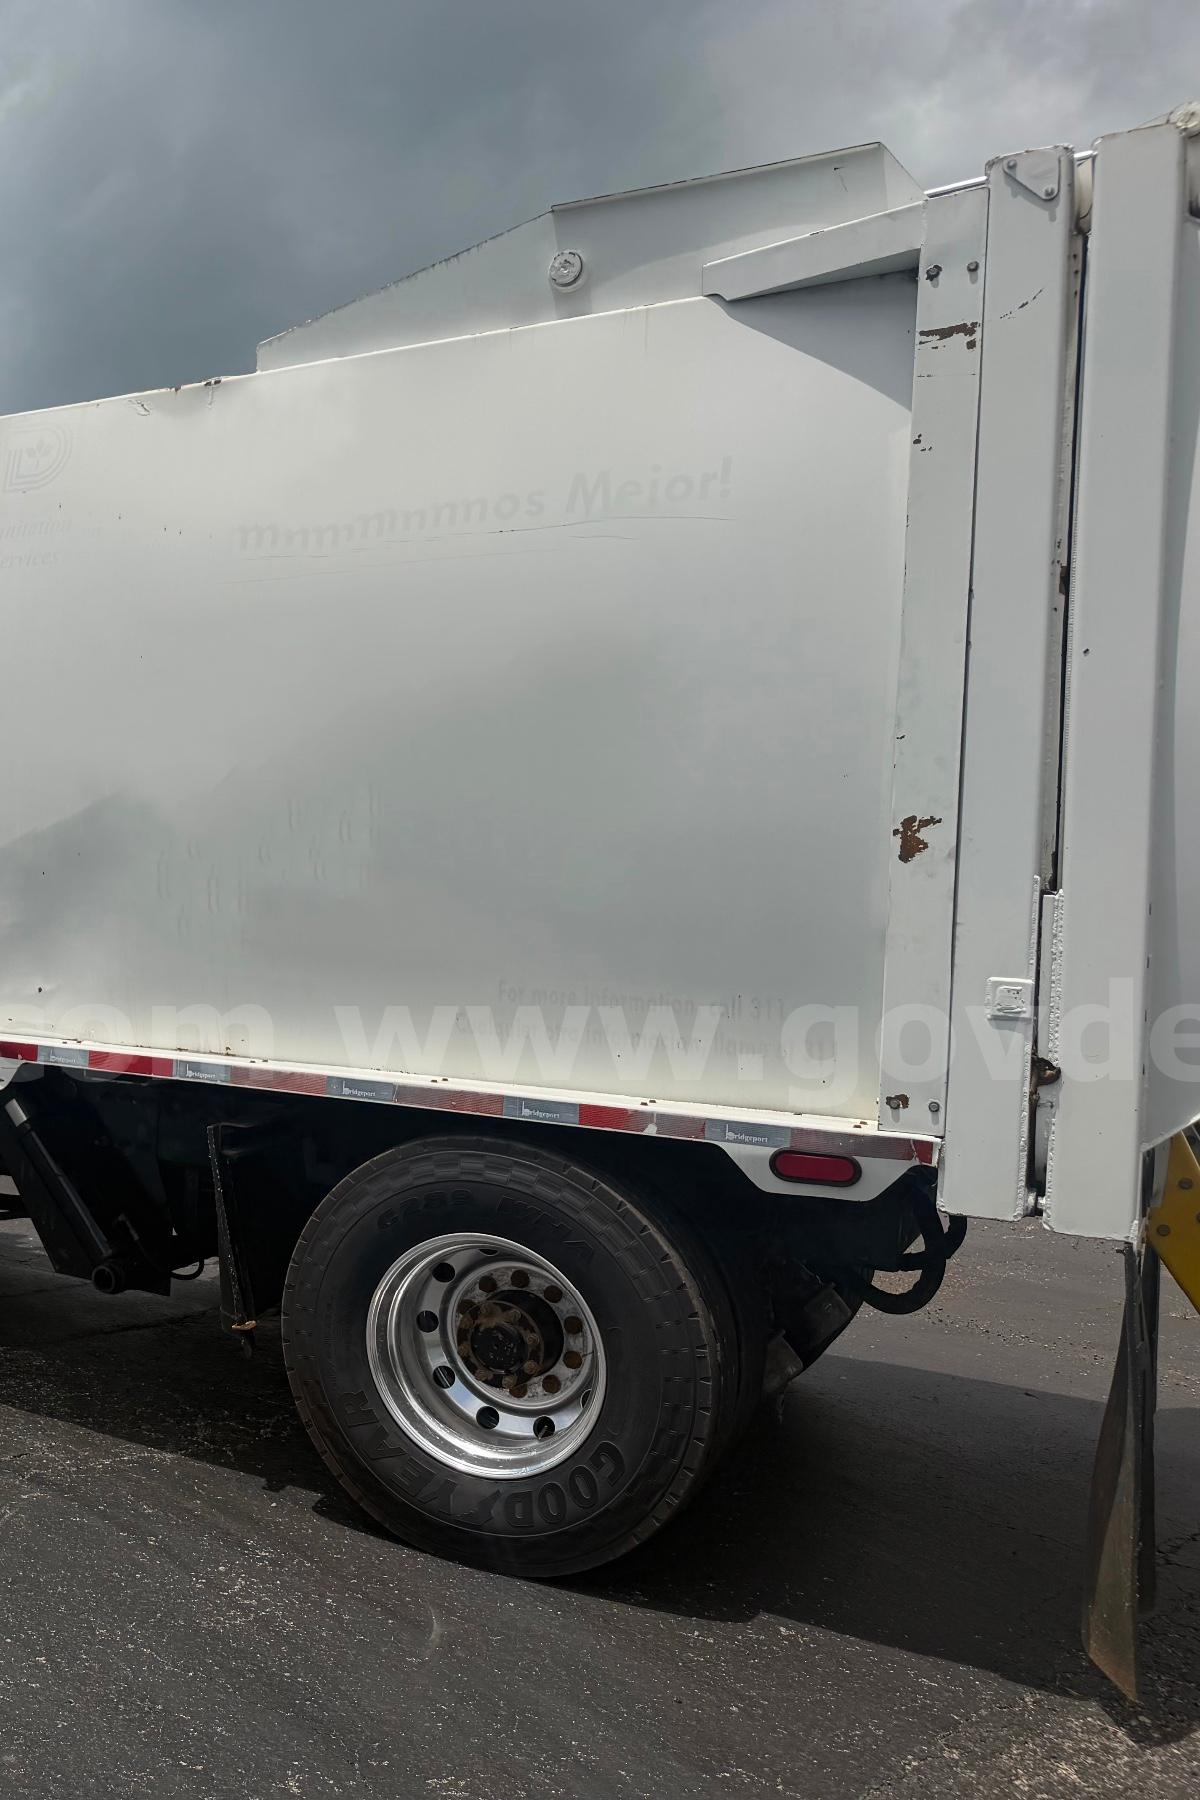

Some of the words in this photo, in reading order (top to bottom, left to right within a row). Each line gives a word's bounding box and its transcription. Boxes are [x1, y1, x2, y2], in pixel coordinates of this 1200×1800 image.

[342, 1081, 376, 1097] bridgeport
[522, 1101, 560, 1119] bridgeport
[726, 1124, 768, 1143] bridgeport
[340, 1388, 626, 1531] GOODYEAR
